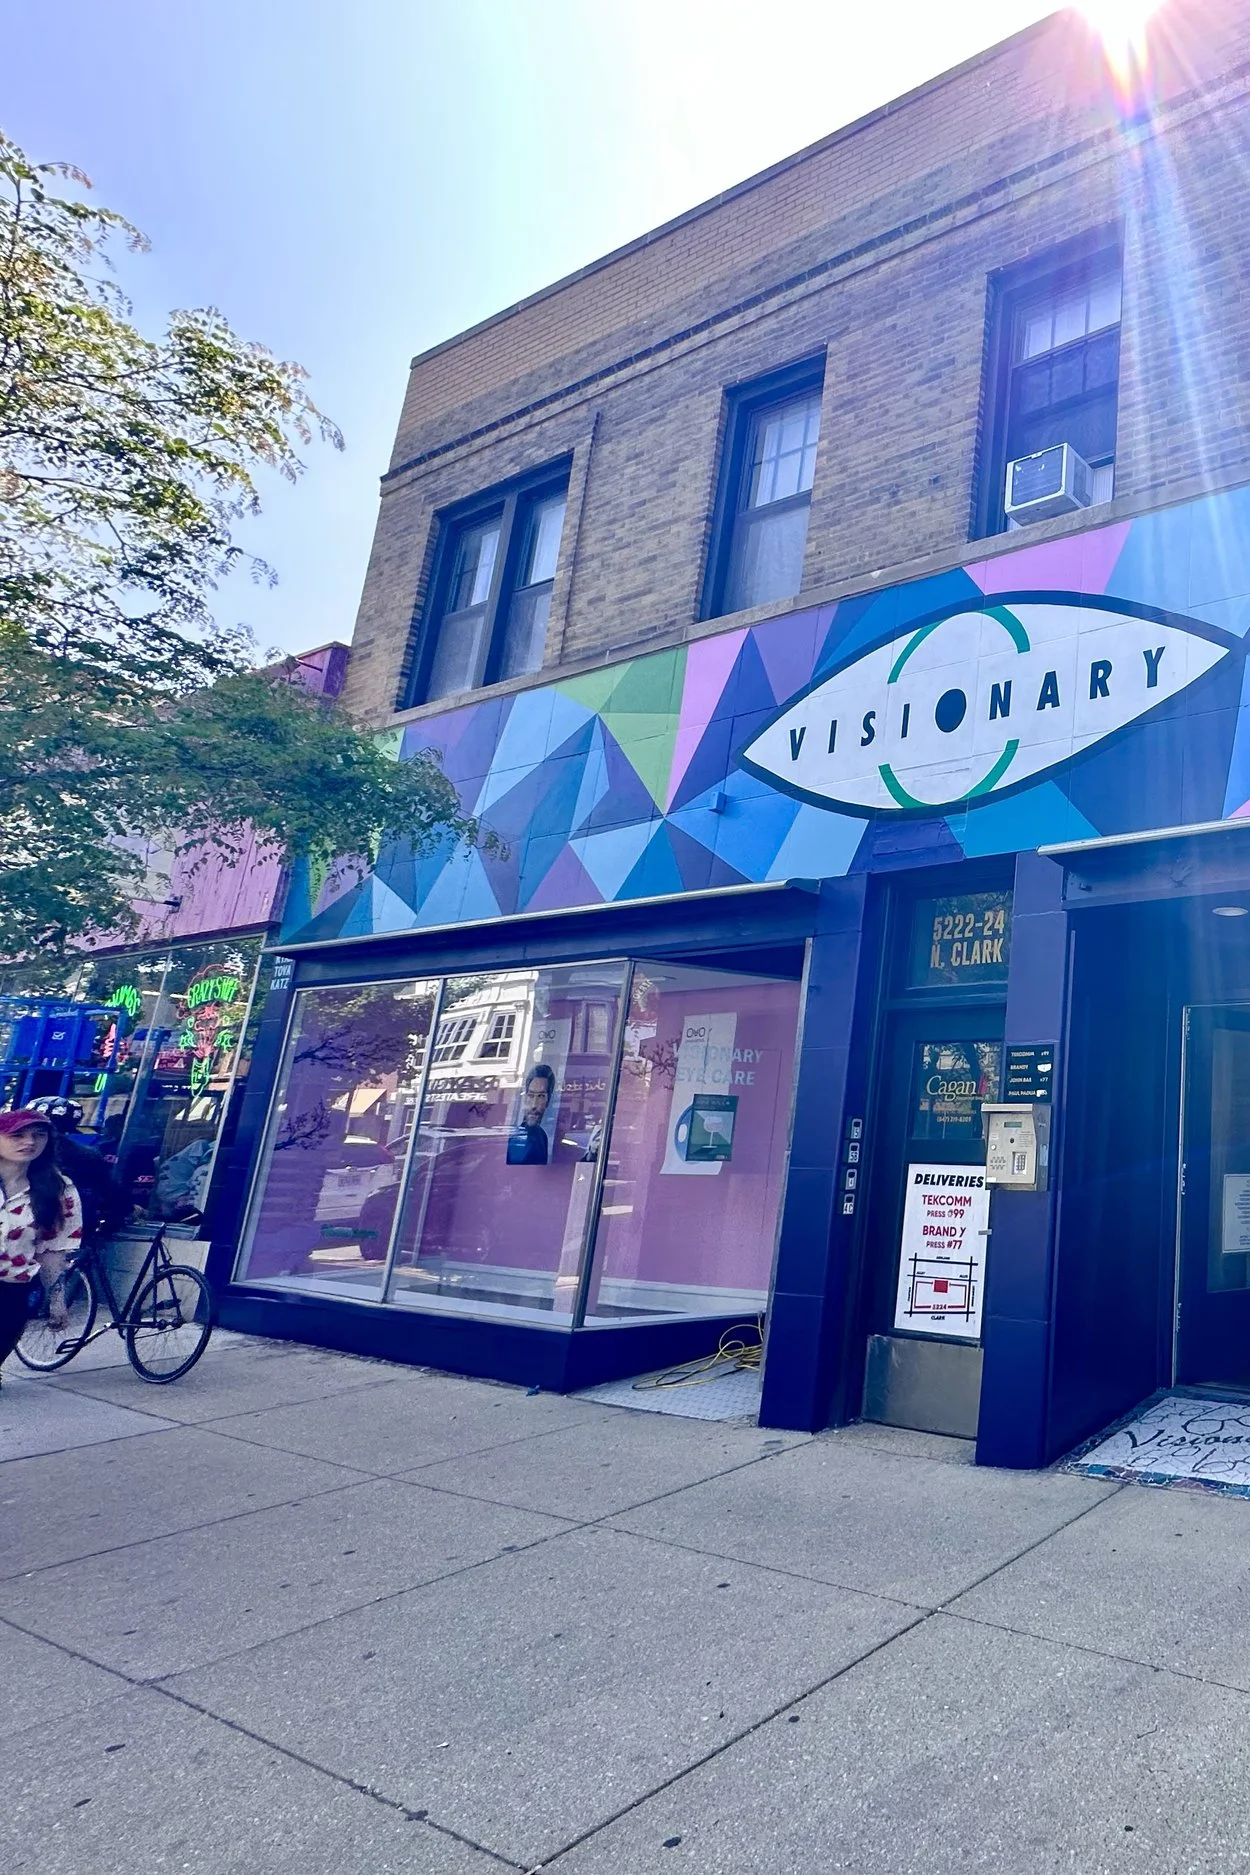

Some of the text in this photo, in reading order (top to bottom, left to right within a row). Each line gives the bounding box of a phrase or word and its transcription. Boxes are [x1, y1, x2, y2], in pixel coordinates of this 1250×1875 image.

[789, 646, 1166, 762] VISIONARY
[933, 911, 1004, 940] 5222-24
[930, 938, 1003, 968] N. CLARK
[270, 977, 290, 991] KATZ
[673, 1044, 764, 1064] VISIONARY
[676, 1069, 756, 1086] EYE CARE
[926, 1075, 977, 1102] Cagan
[914, 1173, 984, 1188] DELIVERIES
[922, 1194, 972, 1207] TEKCOMM
[926, 1209, 946, 1218] PRESS
[922, 1225, 967, 1237] BRAND Y
[925, 1240, 963, 1250] PRESS #77
